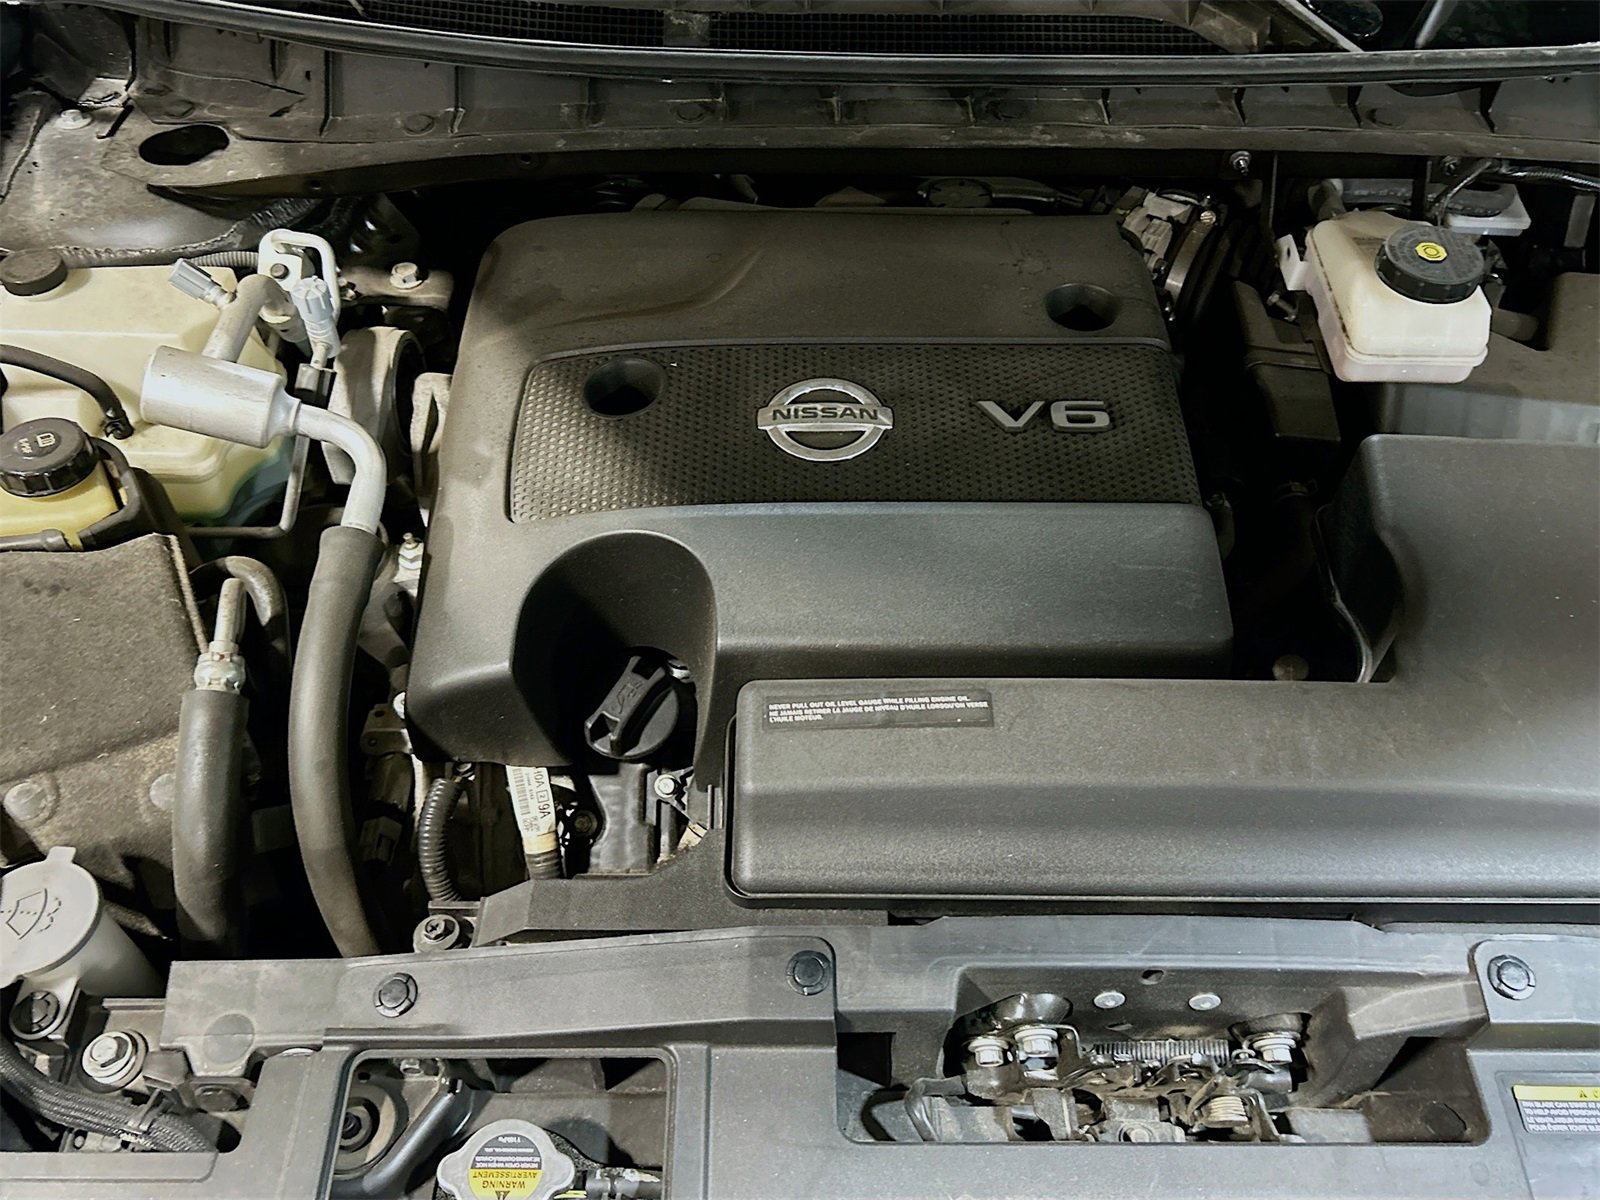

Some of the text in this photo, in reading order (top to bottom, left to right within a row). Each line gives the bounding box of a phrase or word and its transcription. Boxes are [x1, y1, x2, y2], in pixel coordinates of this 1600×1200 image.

[772, 407, 878, 420] NISSAN
[976, 400, 1112, 431] V6
[538, 803, 551, 820] 9A
[473, 1171, 538, 1179] AVERTISSEMENT
[482, 1181, 525, 1189] WARNING
